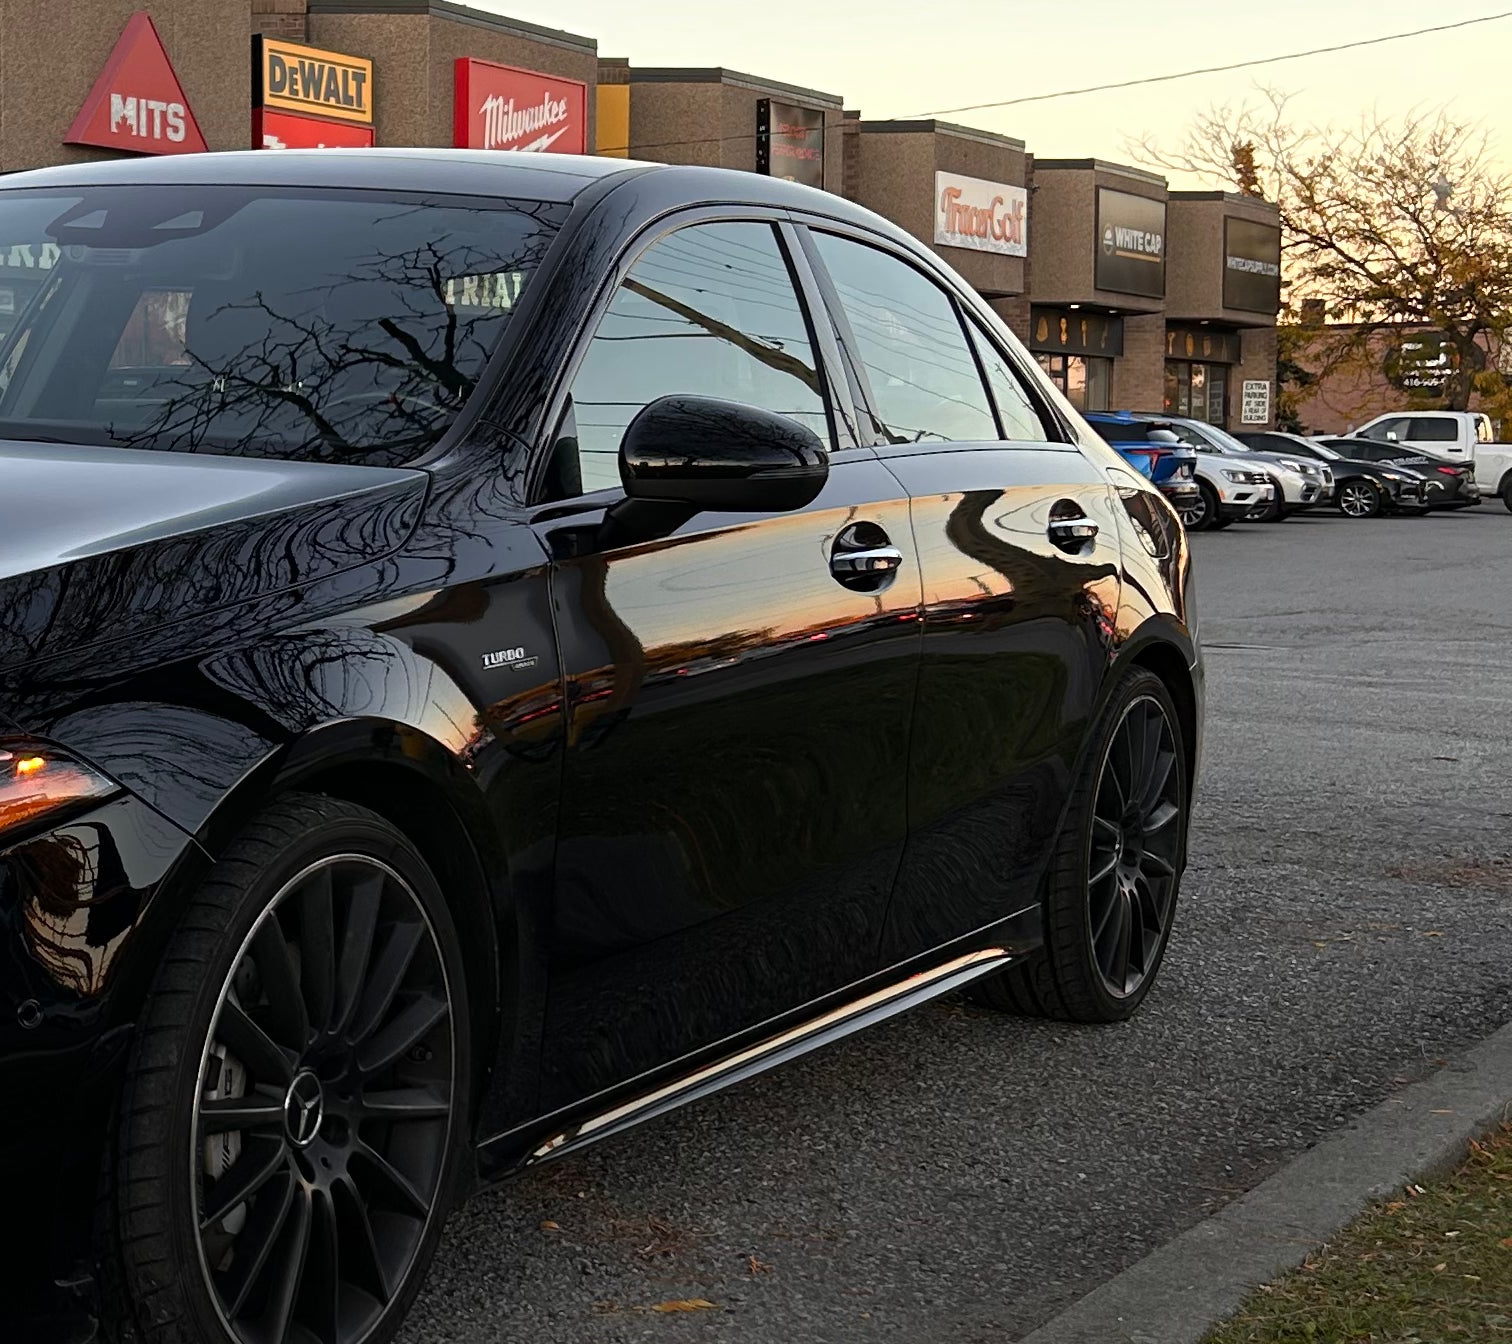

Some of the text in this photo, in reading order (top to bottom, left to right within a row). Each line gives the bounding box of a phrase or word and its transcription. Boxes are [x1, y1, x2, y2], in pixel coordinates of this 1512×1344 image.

[110, 93, 185, 143] MITS
[479, 91, 568, 149] Milwaukee
[1115, 226, 1162, 254] WHITE CAP
[1245, 382, 1267, 390] EXTRA
[1245, 391, 1267, 399] PARKING
[481, 647, 525, 666] TURBO
